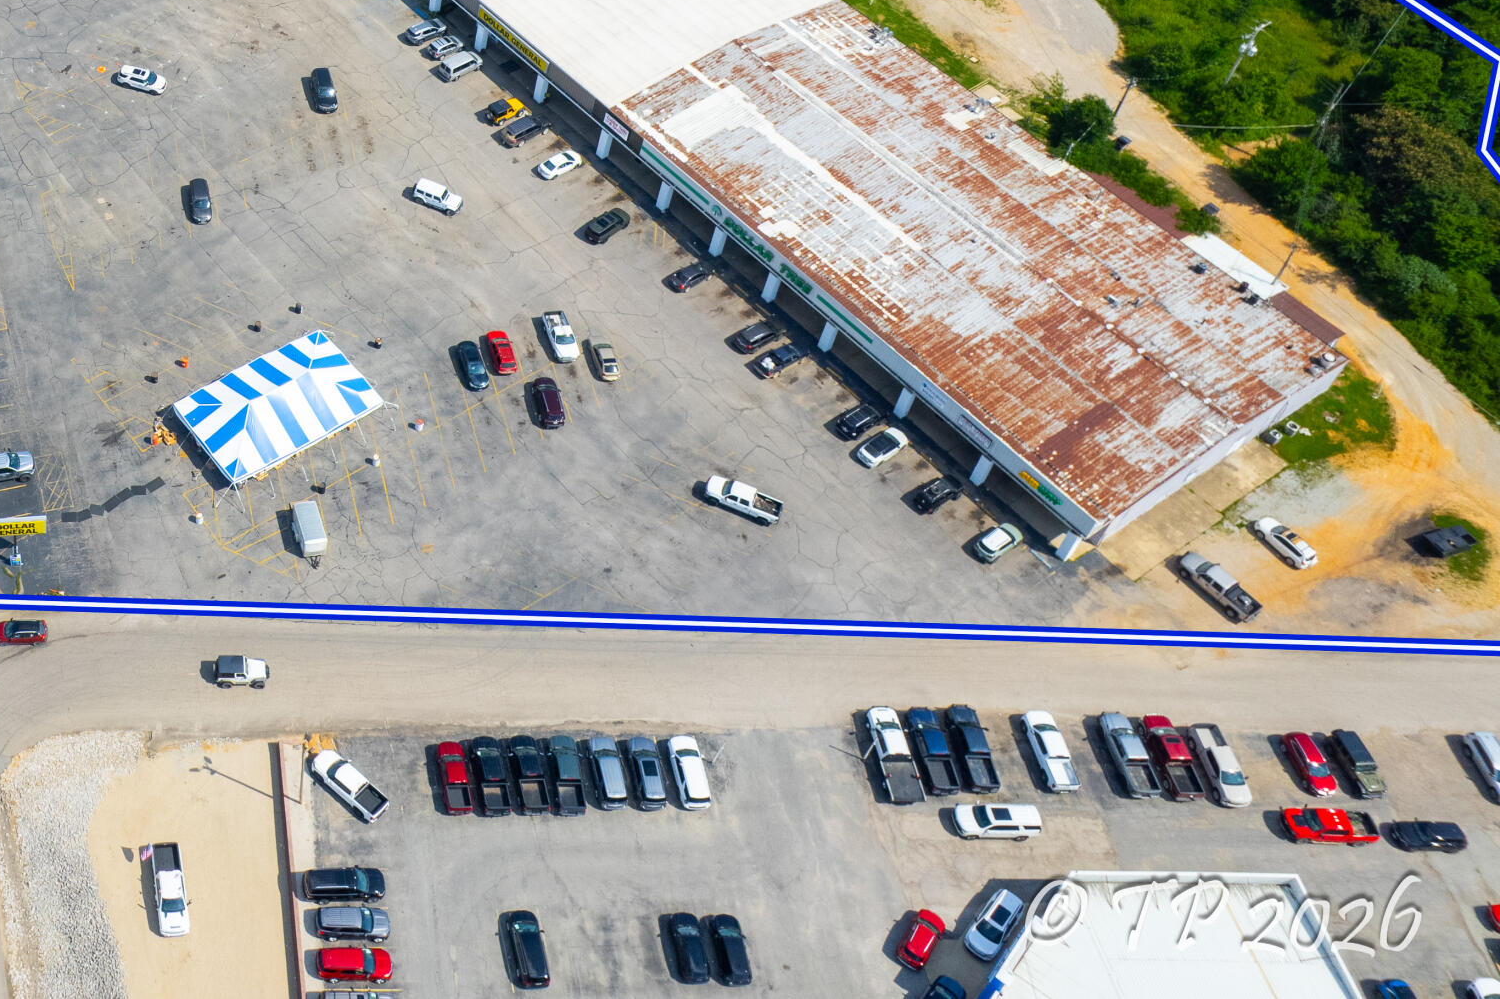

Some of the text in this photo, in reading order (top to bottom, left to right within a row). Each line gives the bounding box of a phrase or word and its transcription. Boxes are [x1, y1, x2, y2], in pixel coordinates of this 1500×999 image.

[483, 12, 543, 68] DOLLAR GENERAL
[723, 217, 813, 295] DOLLAR TREE
